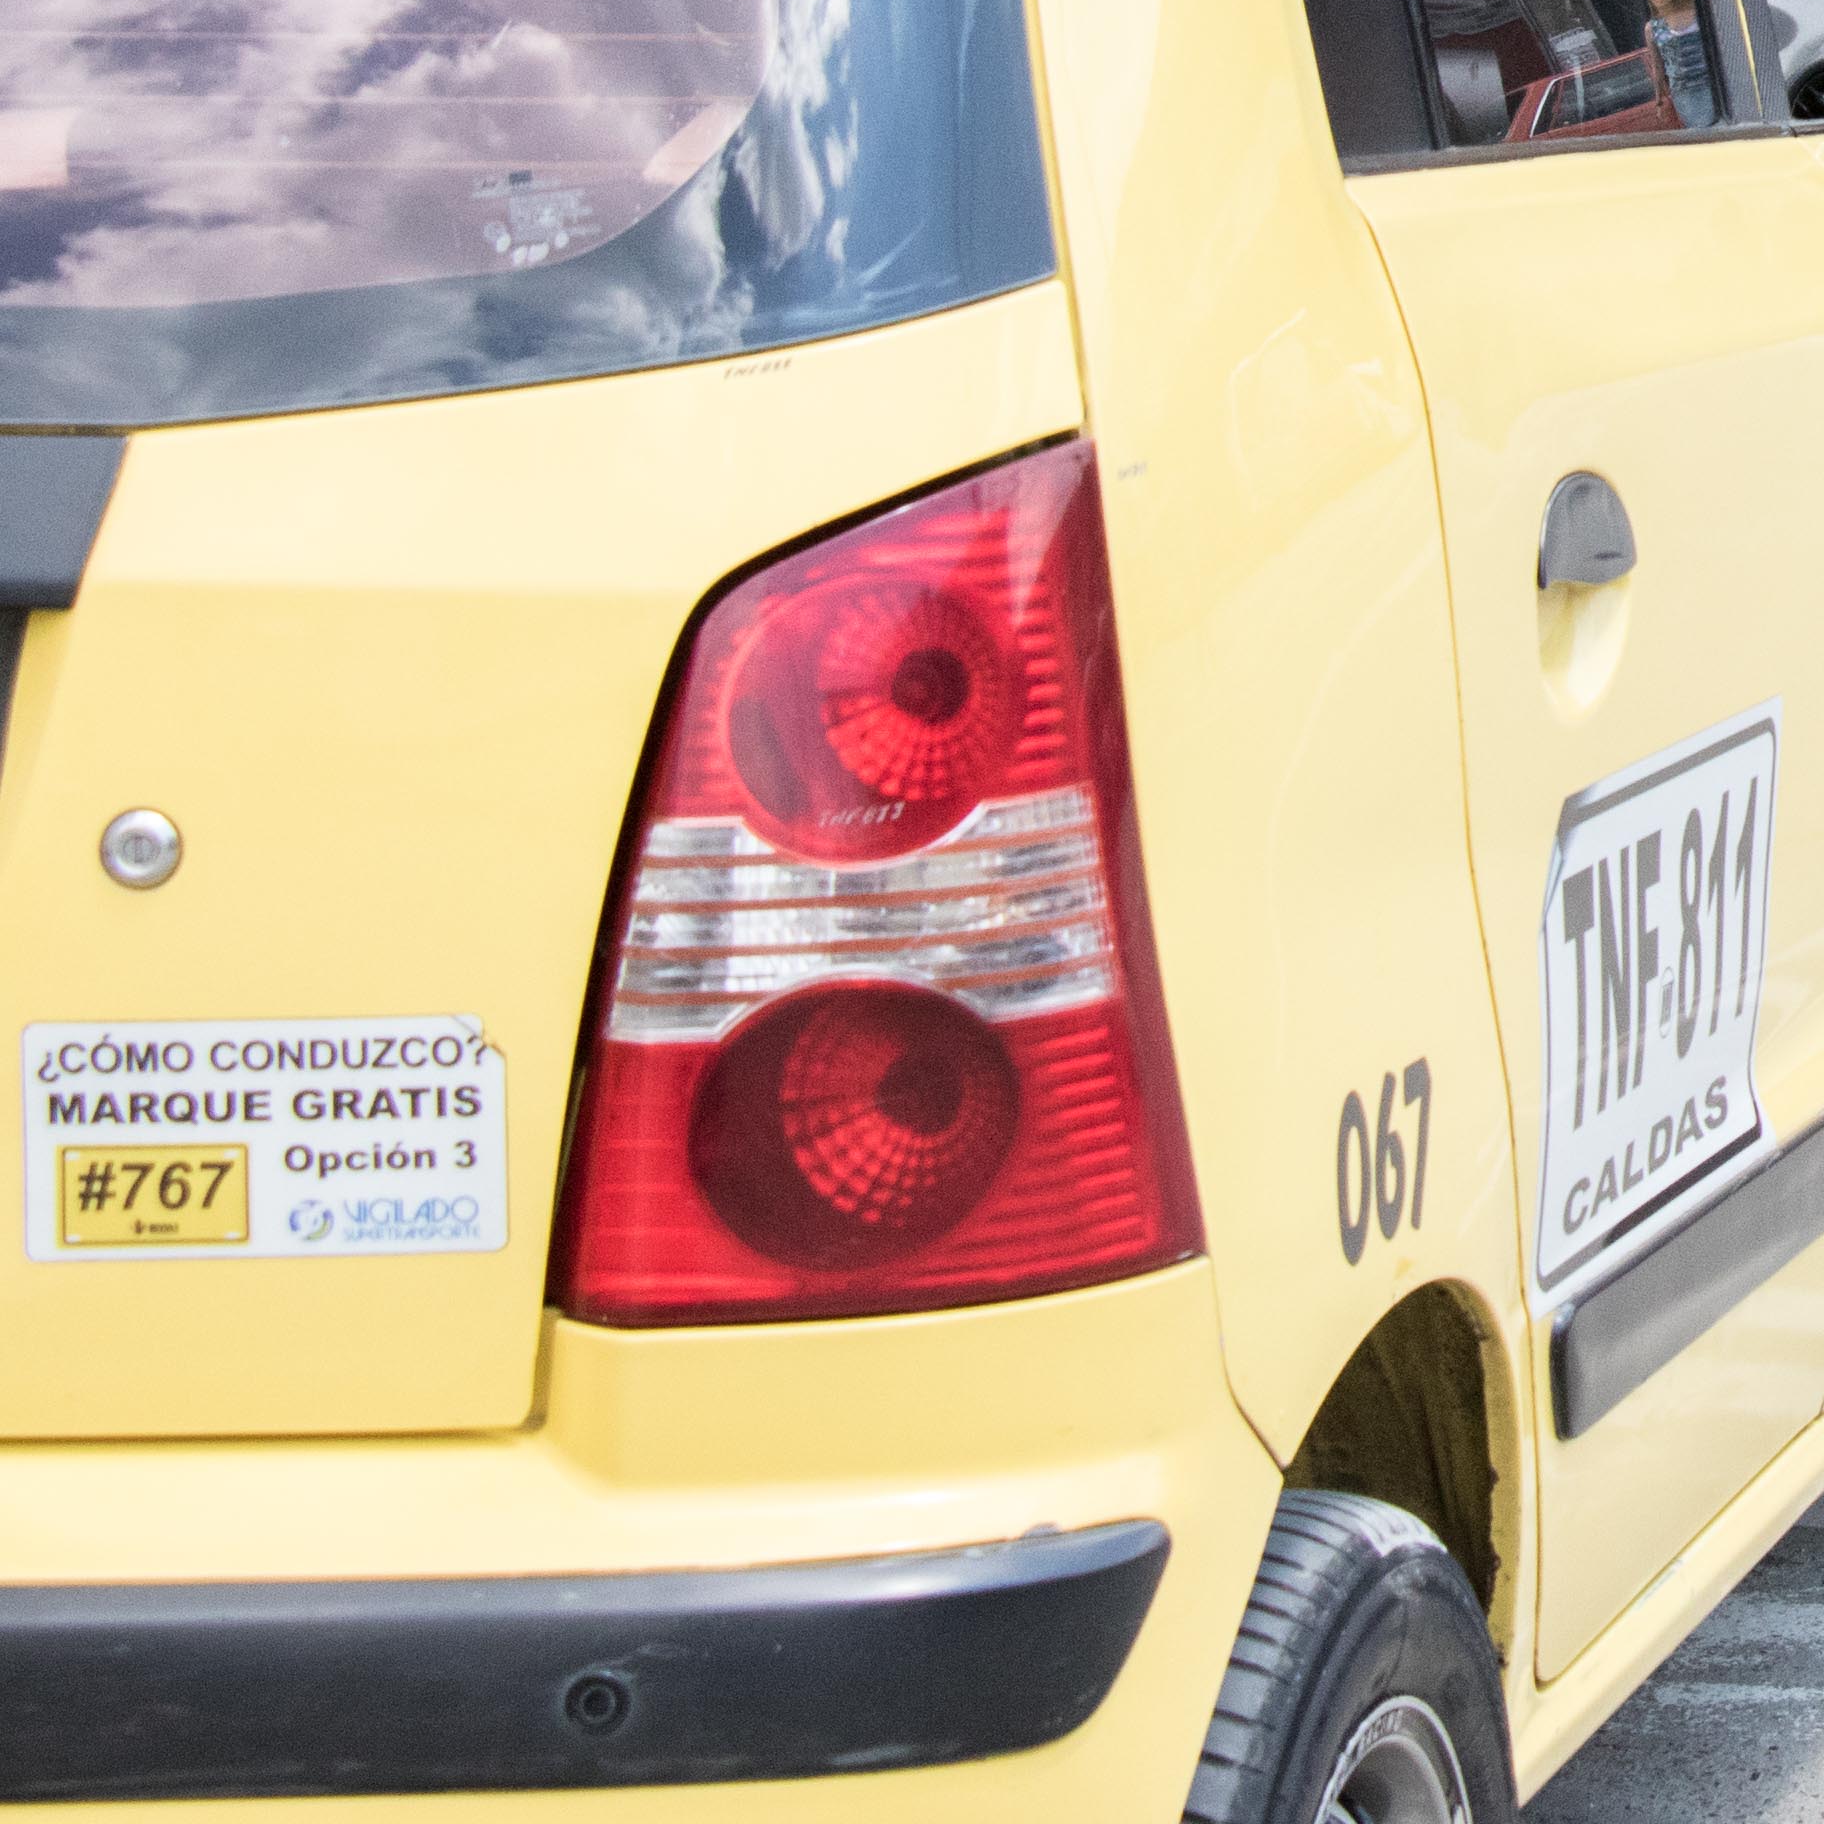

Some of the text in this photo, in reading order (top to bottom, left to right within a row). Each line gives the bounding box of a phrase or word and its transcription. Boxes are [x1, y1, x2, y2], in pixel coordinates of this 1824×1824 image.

[36, 1033, 489, 1083] ¿CÓMO CONDUZCO?
[48, 1085, 484, 1126] MARQUE GRATIS
[284, 1140, 479, 1179] Opción 3
[1337, 1057, 1432, 1267] 067
[1562, 1075, 1730, 1237] CALDAS
[78, 1160, 235, 1211] #767
[343, 1194, 480, 1224] VIGILADO
